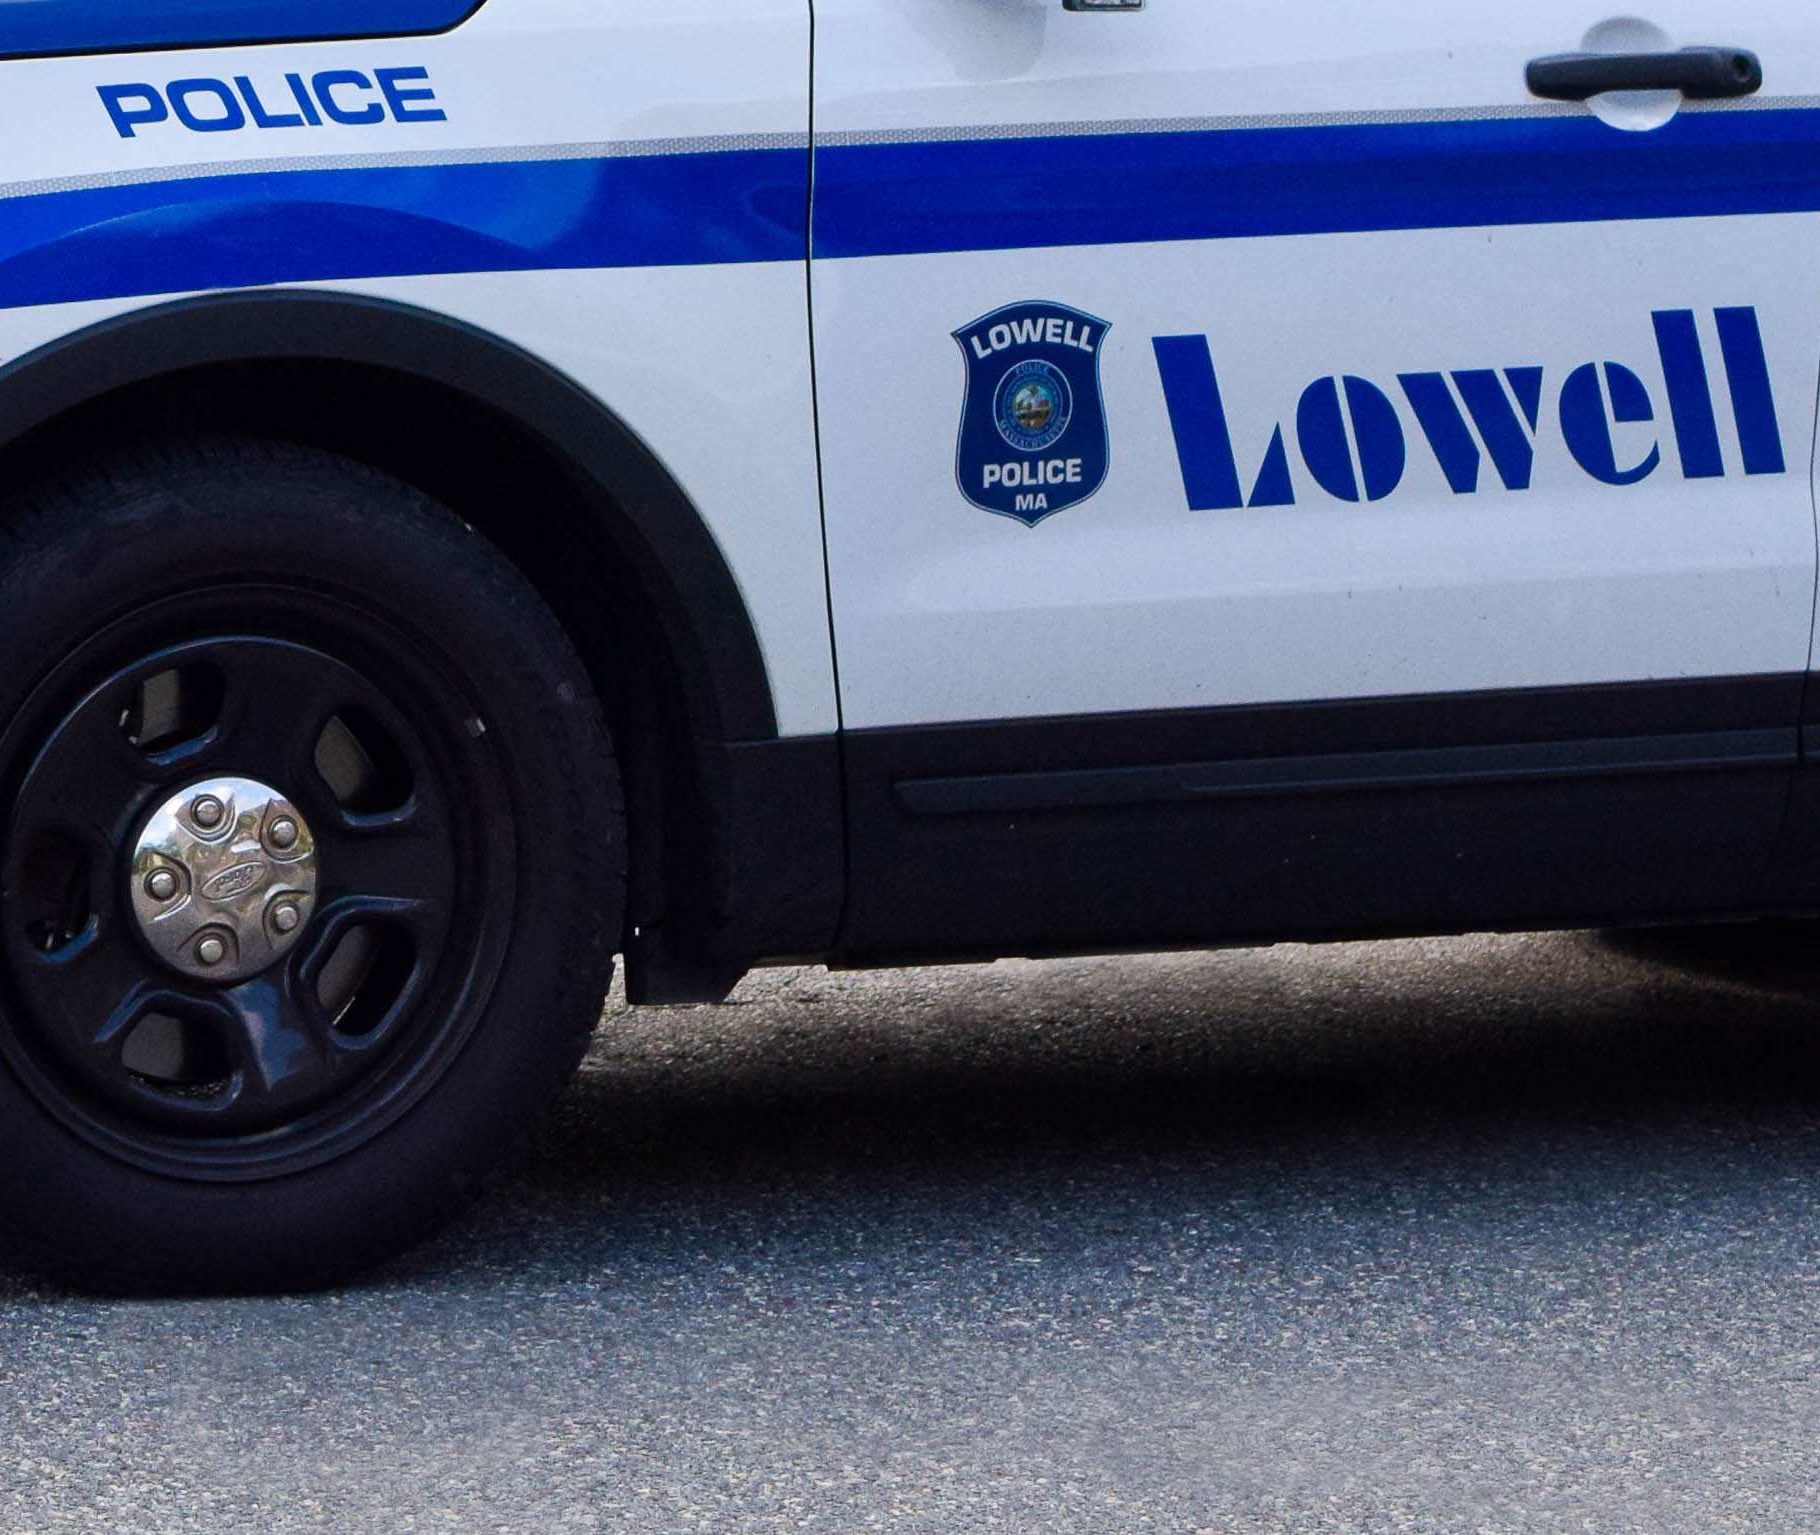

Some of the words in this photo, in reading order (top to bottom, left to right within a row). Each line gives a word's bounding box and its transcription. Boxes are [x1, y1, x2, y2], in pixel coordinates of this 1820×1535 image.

[96, 66, 448, 139] POLICE
[970, 317, 1094, 360] LOWELL
[1151, 305, 1787, 512] Lowell
[983, 458, 1083, 488] POLICE
[1014, 493, 1048, 511] MA
